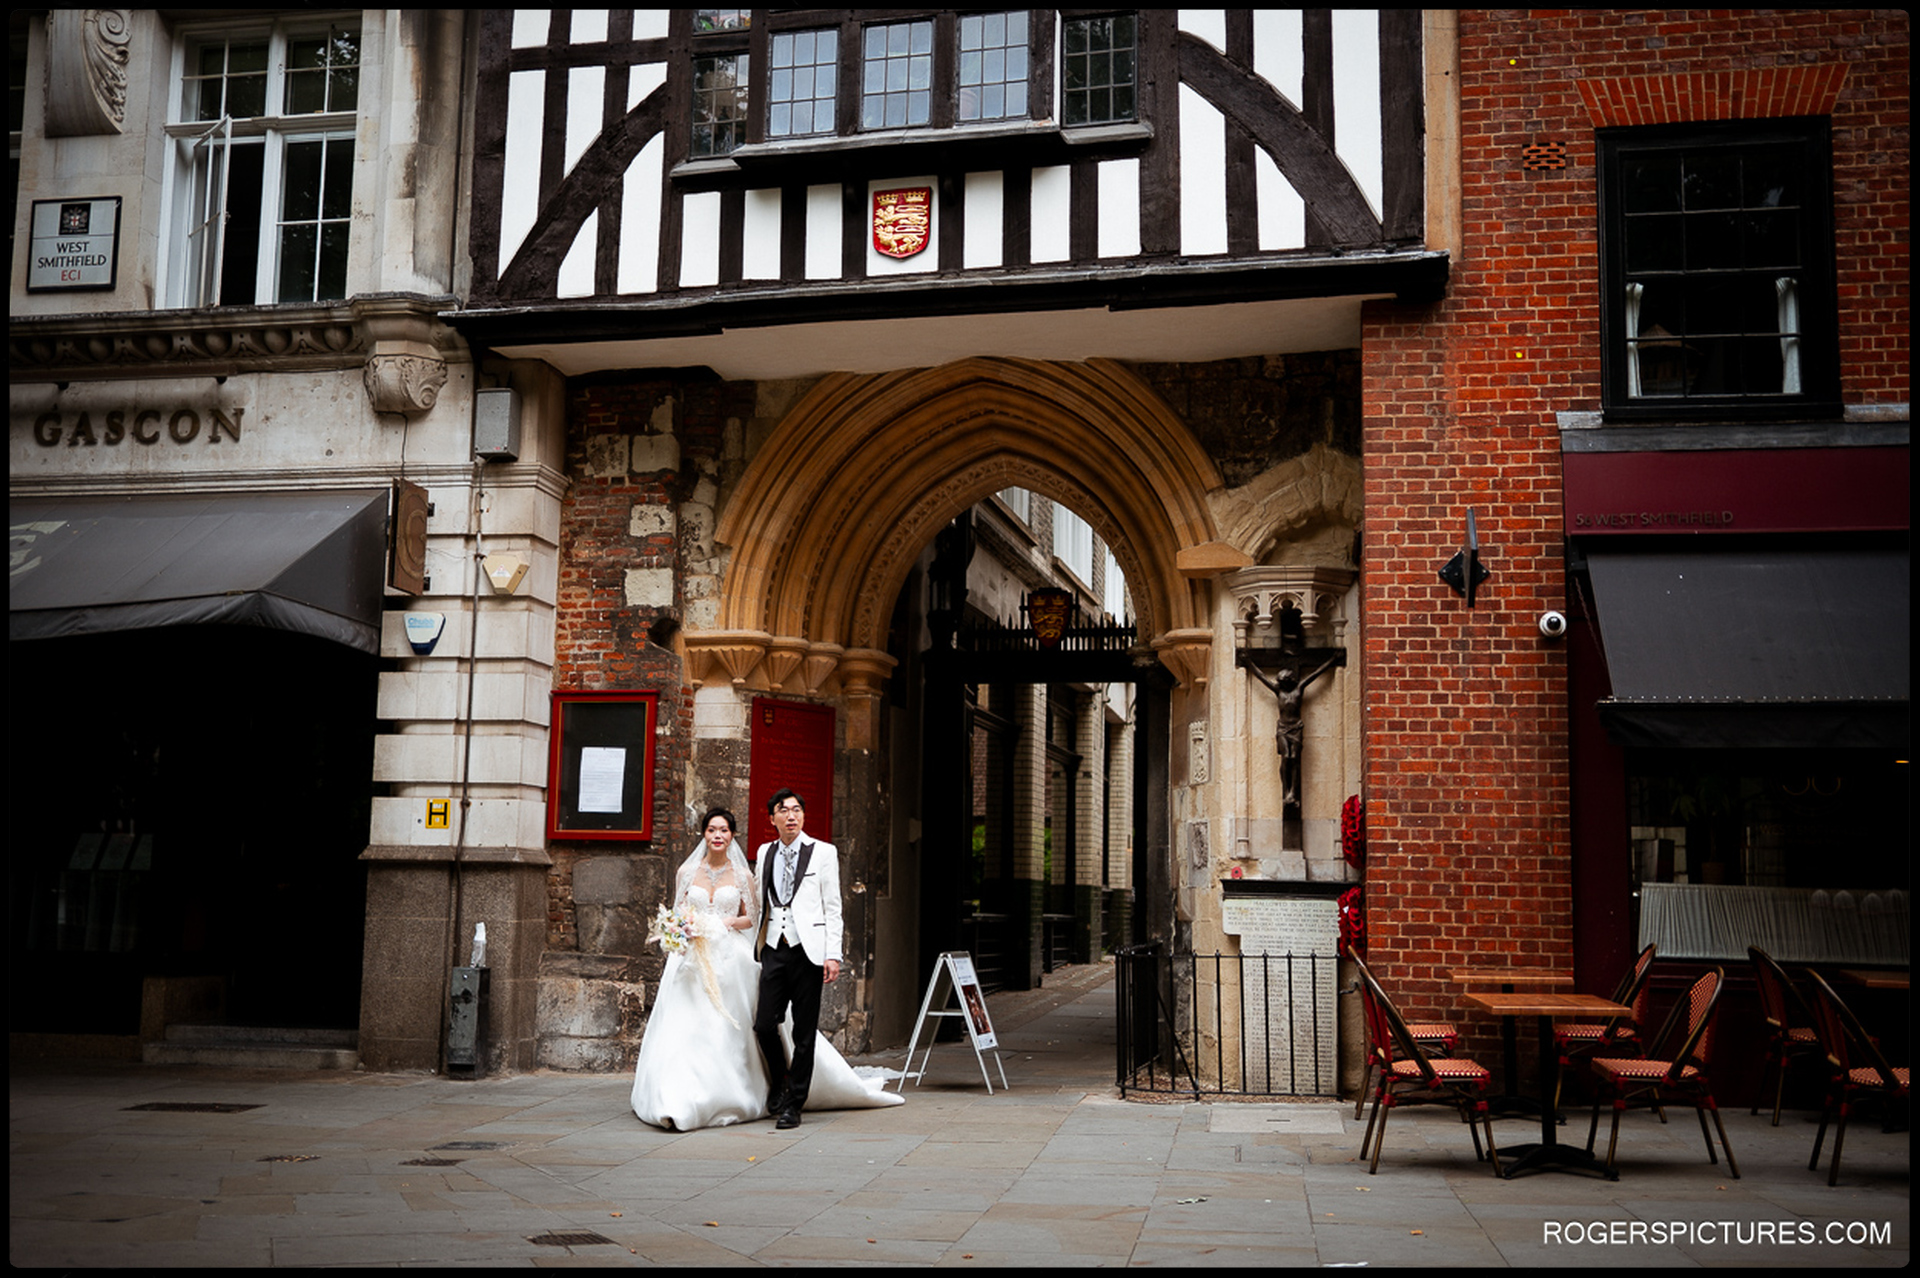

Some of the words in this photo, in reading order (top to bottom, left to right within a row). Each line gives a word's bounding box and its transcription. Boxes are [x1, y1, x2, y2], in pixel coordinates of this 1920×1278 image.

[56, 241, 90, 253] WEST
[37, 254, 107, 269] SMITHFIELD
[33, 408, 245, 447] GASCON
[1594, 512, 1637, 526] WEST
[1640, 510, 1734, 525] SMITHFIELD
